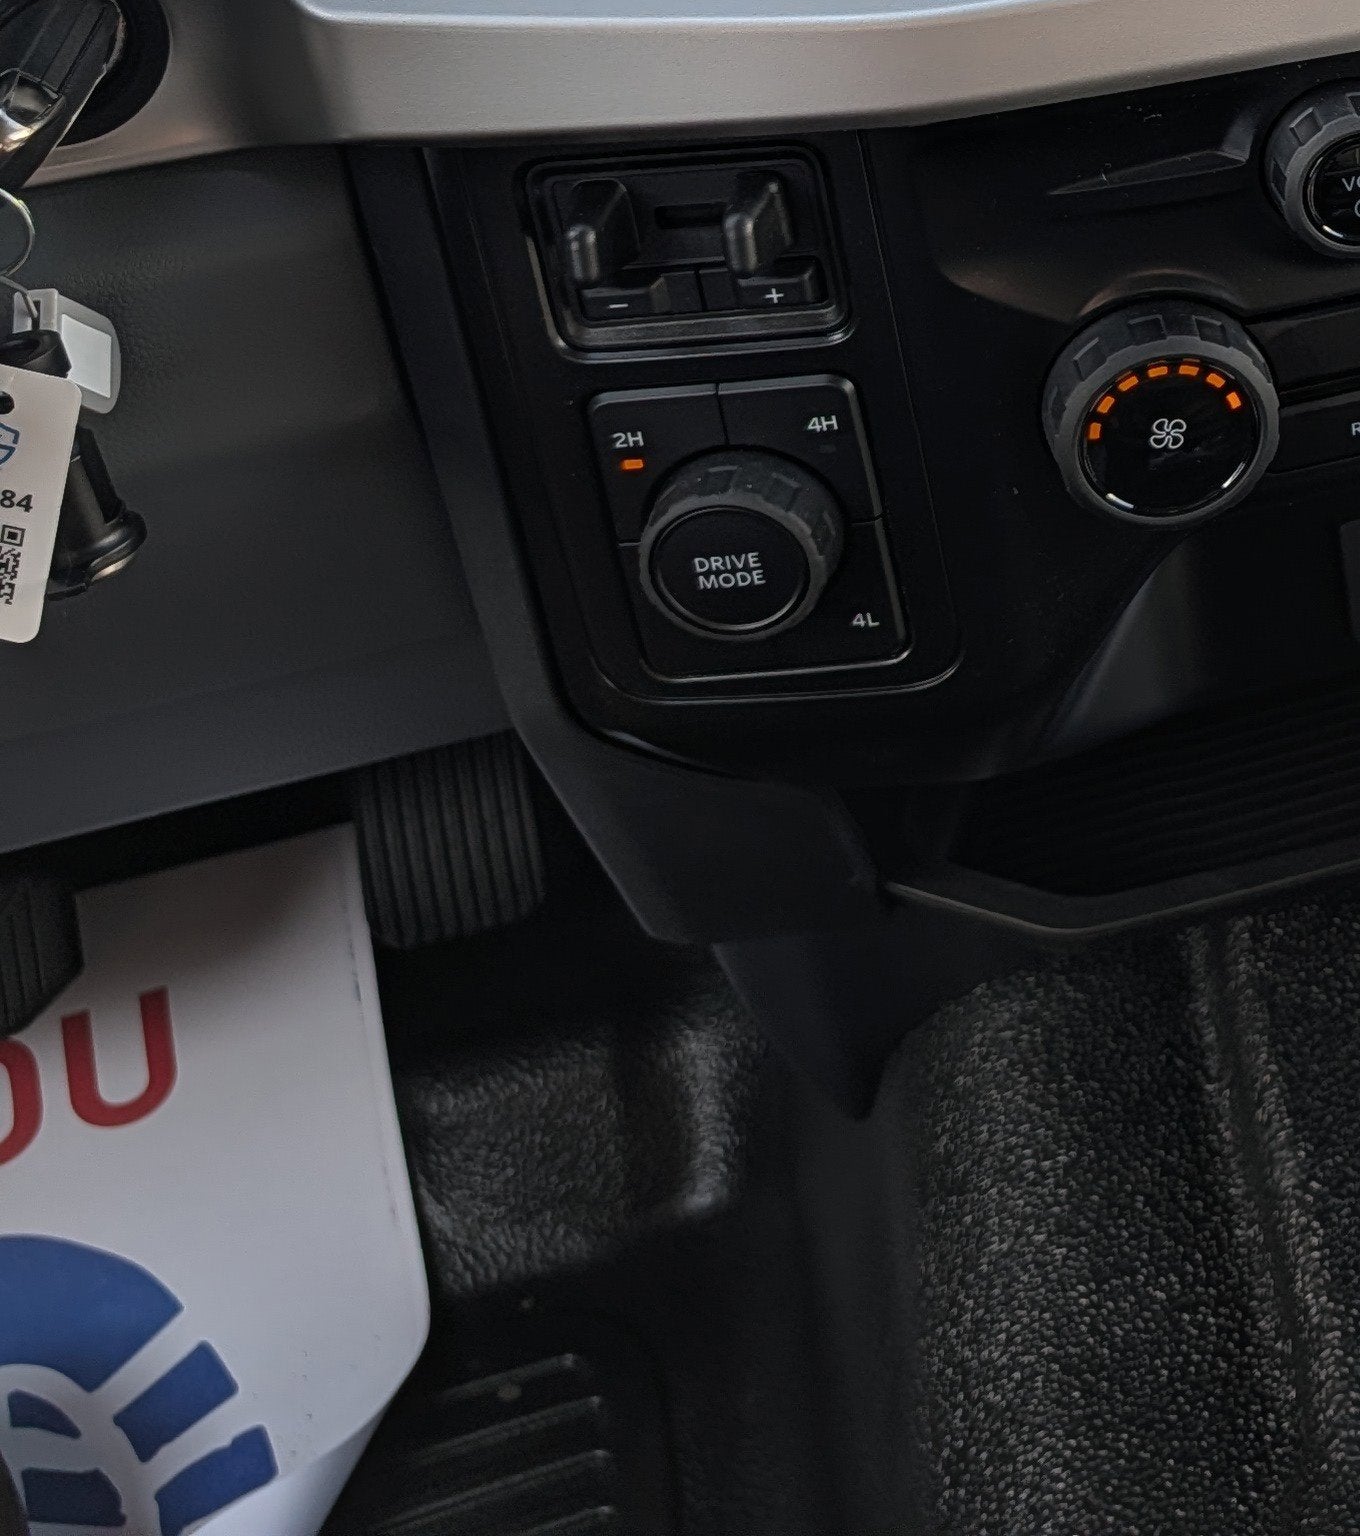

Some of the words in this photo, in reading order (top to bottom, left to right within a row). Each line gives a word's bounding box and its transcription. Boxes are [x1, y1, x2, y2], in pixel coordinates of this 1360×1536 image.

[807, 415, 838, 433] 4H
[613, 431, 644, 448] 2H
[693, 551, 762, 574] DRIVE
[698, 568, 766, 590] MODE
[851, 612, 879, 629] 4L
